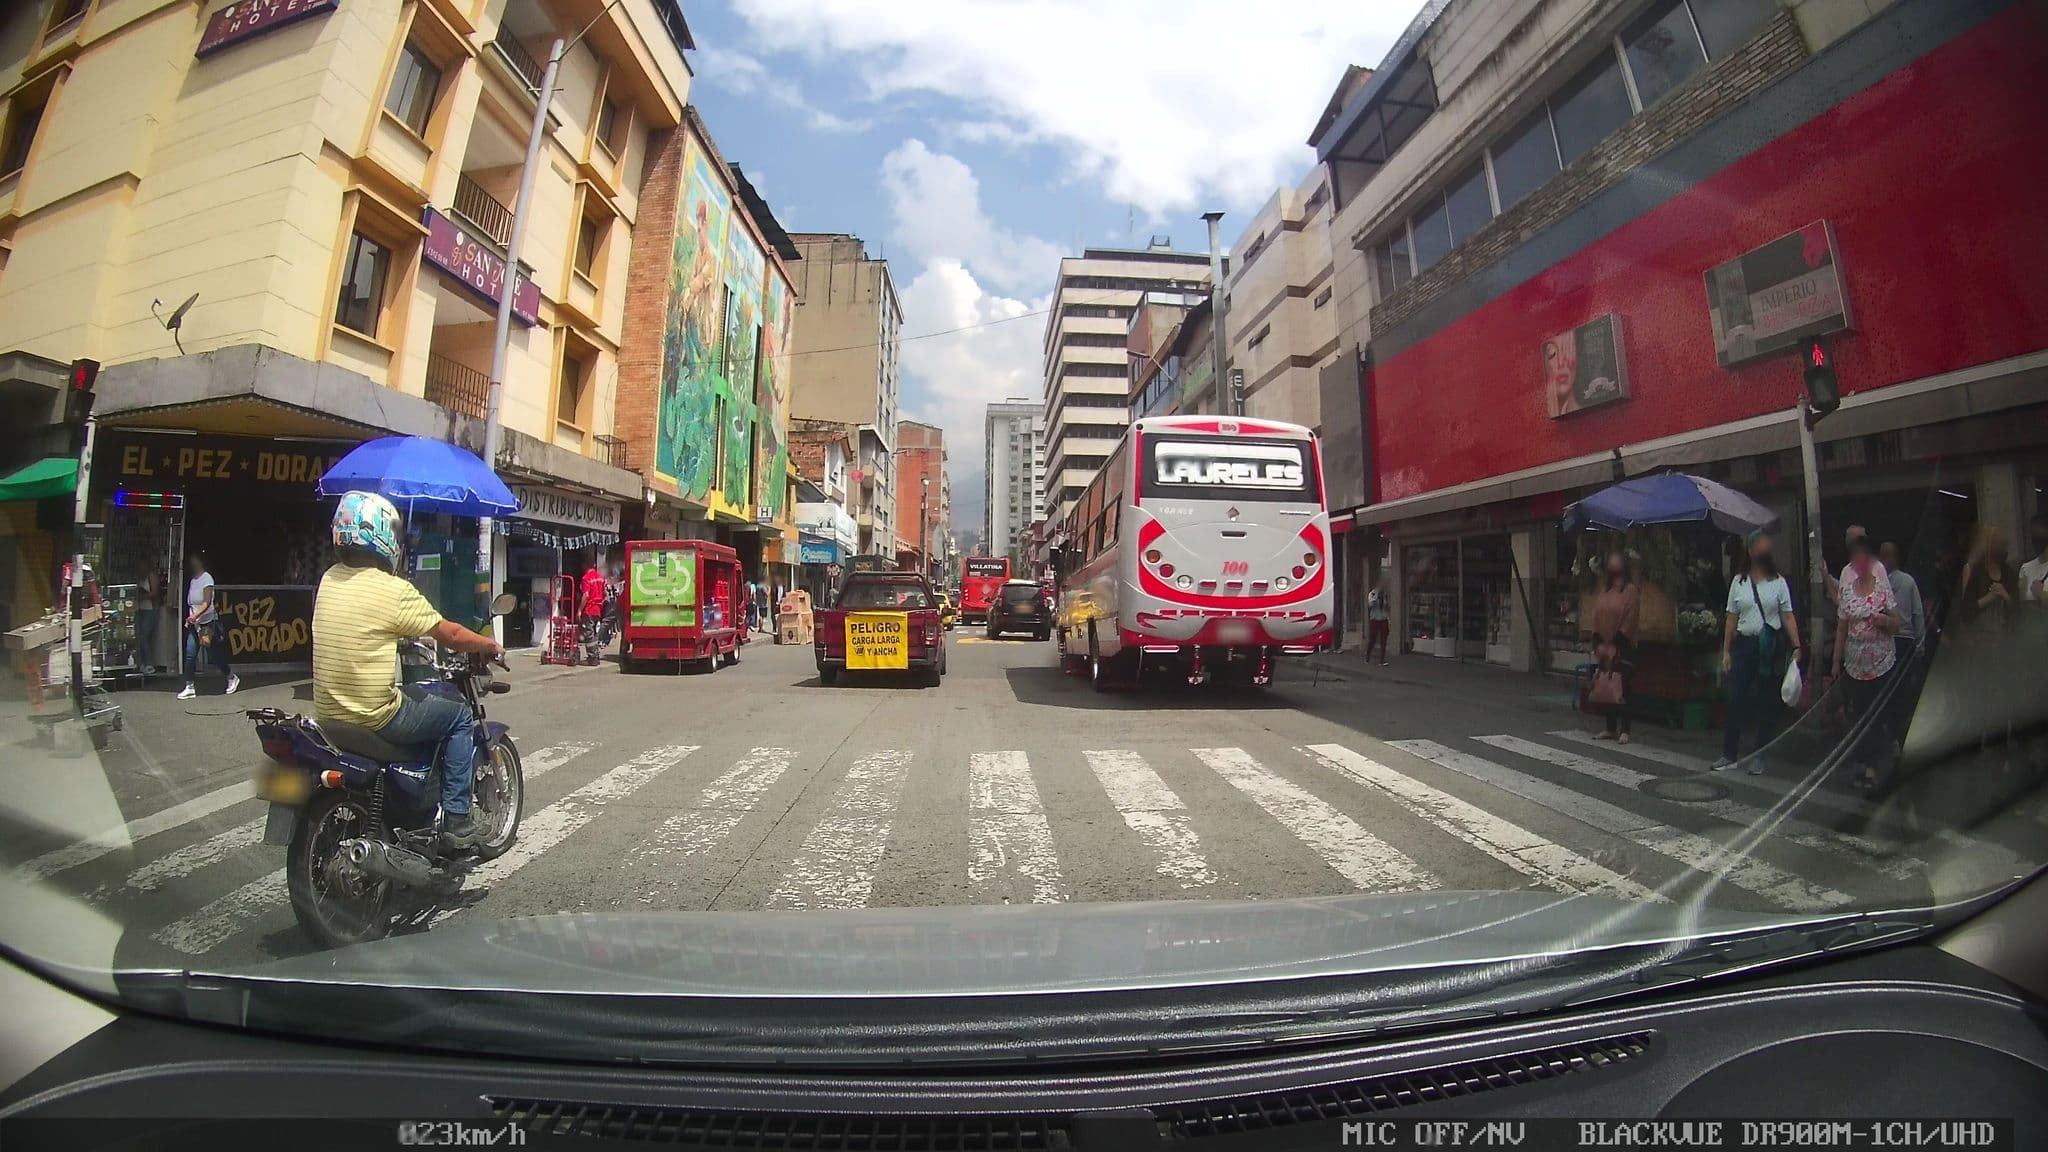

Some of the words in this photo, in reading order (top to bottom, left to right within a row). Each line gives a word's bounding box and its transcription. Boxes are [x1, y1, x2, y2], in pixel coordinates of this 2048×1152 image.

[229, 0, 314, 33] HOTE
[464, 243, 492, 274] SAN
[492, 261, 522, 297] JÉ
[462, 263, 519, 312] HOTL
[1760, 279, 1817, 313] IMPERIO
[121, 445, 154, 476] EL
[178, 447, 233, 478] PEZ
[1157, 459, 1304, 486] LAURELES
[518, 487, 614, 526] DISTRIBUCIONES
[1220, 560, 1249, 576] 100
[235, 596, 276, 627] PEZ
[850, 622, 901, 634] PELIGRO
[228, 617, 308, 656] DORADO
[851, 636, 876, 646] CARGA
[877, 635, 901, 644] LARGA
[866, 648, 872, 656] Y
[873, 647, 898, 656] ANCHA
